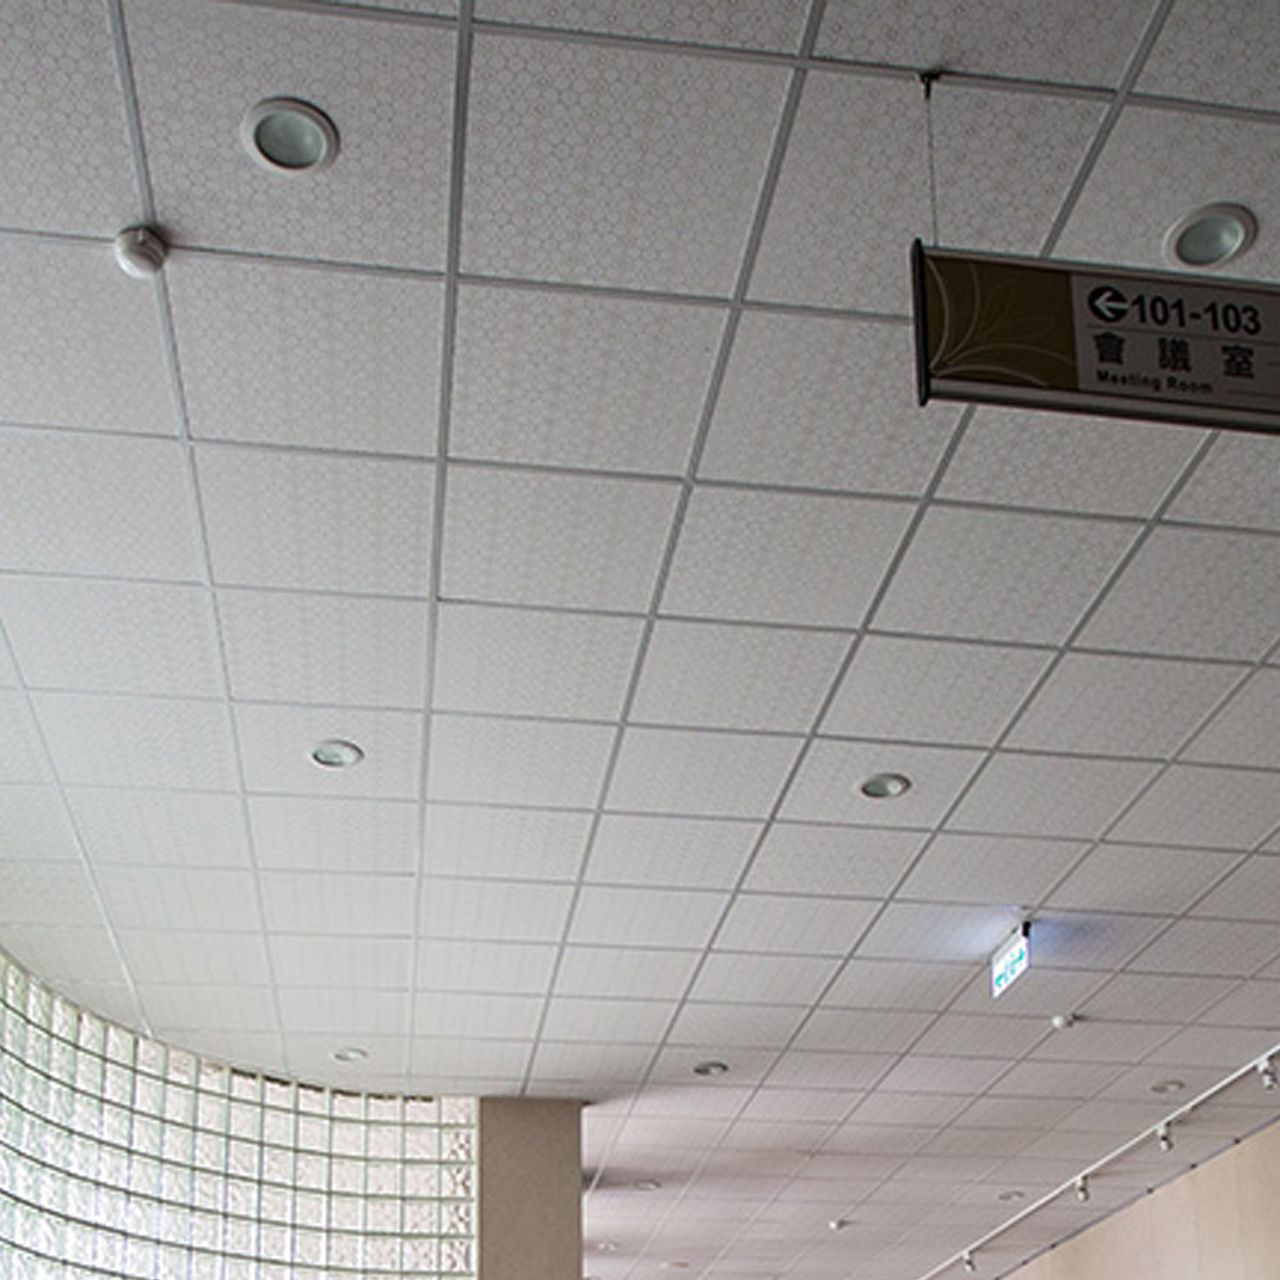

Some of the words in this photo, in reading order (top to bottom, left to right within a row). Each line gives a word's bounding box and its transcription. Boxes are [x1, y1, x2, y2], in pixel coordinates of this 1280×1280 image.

[1131, 295, 1262, 335] 101-103
[1096, 369, 1162, 392] Meeting
[1166, 376, 1213, 394] Room
